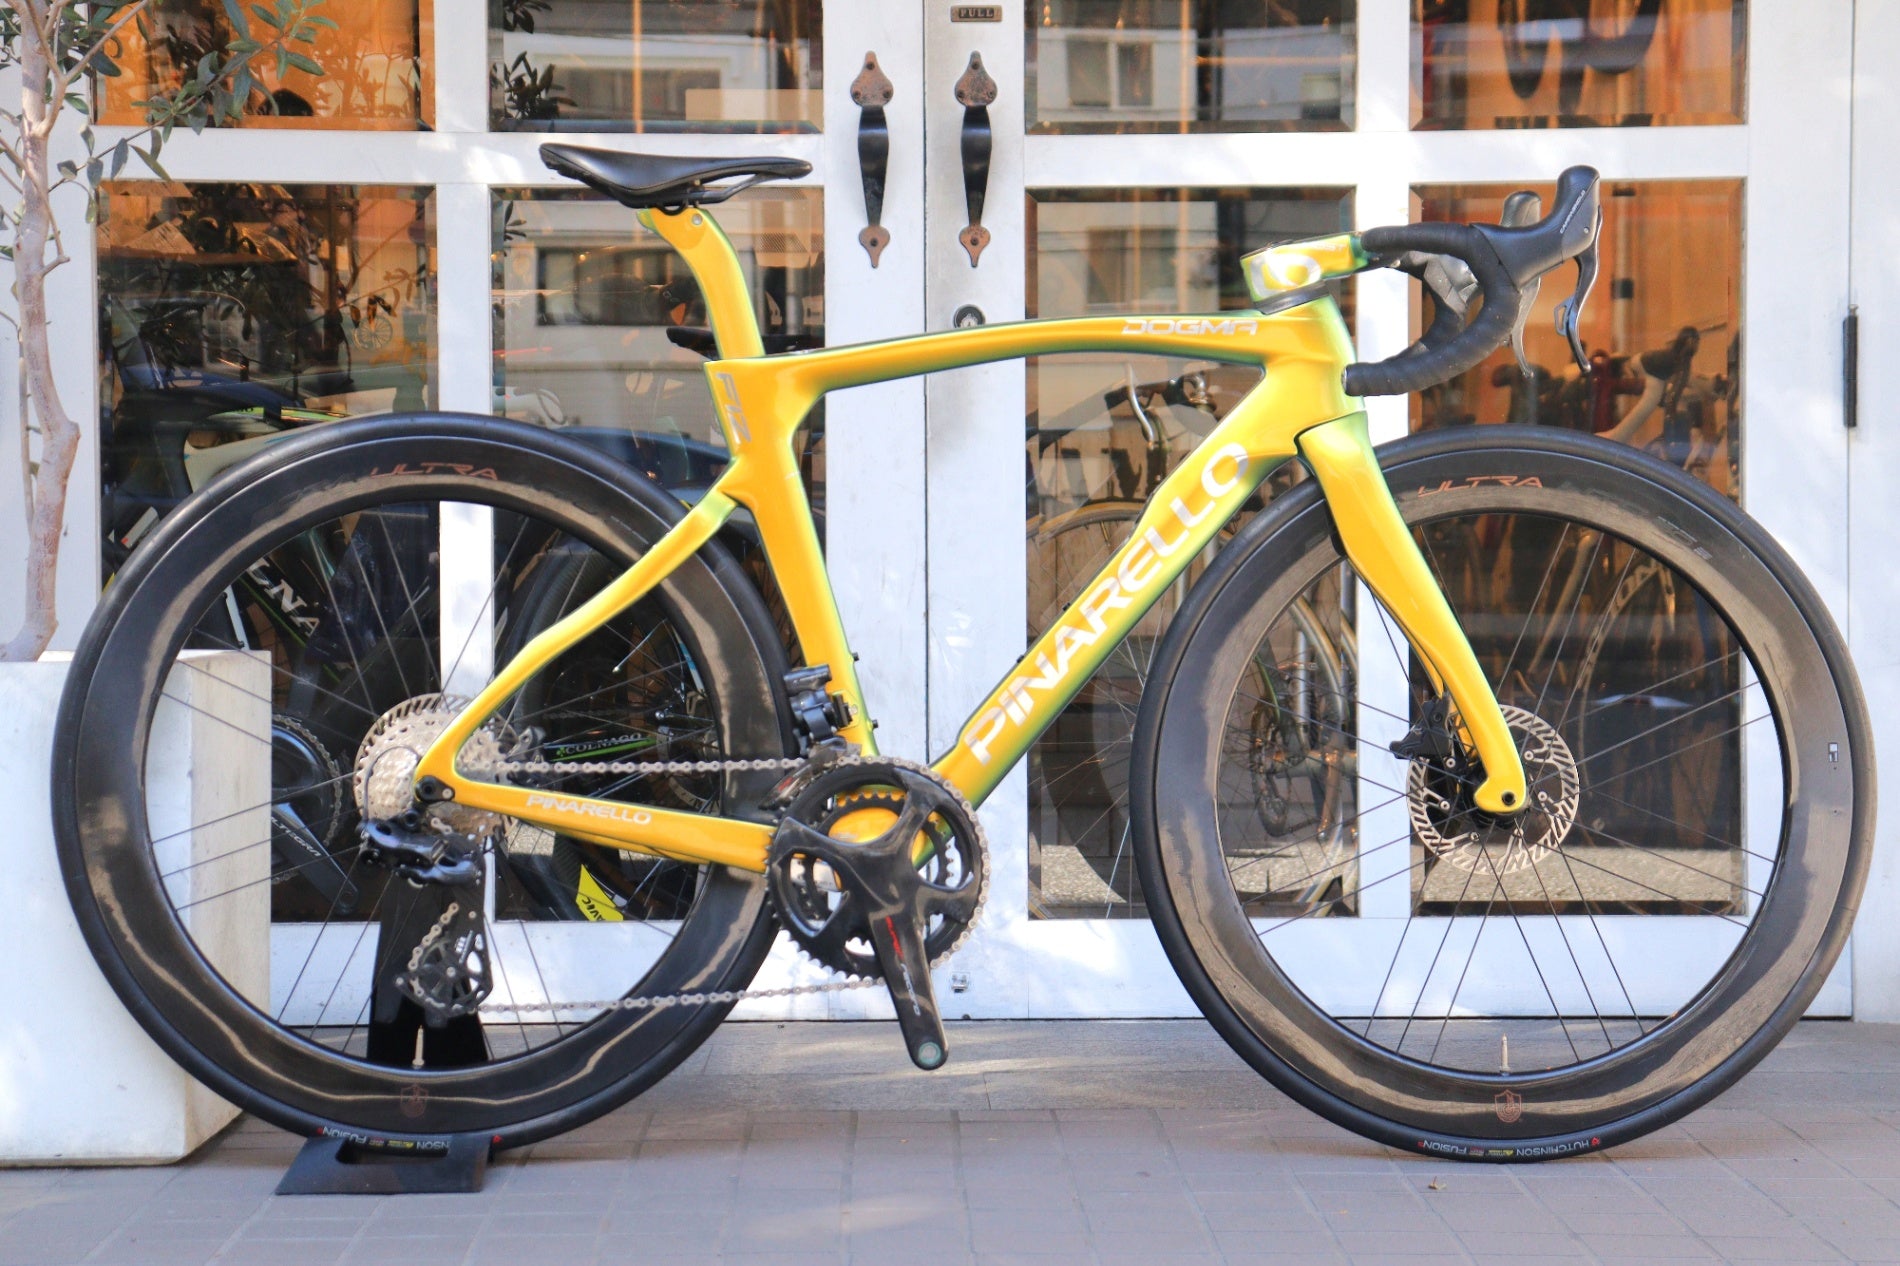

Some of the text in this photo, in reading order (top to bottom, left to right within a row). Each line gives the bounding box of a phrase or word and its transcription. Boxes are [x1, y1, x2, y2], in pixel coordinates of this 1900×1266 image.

[960, 7, 994, 18] PULL
[1121, 319, 1259, 336] DOGMA
[370, 462, 499, 481] ULTRA
[1418, 475, 1543, 498] ULTRA
[963, 442, 1250, 766] PINARELLO
[566, 732, 642, 755] COLNAGO
[526, 794, 652, 825] PINARELLO
[271, 816, 321, 857] LTEGRA
[1423, 1139, 1467, 1155] FUSION
[1516, 1139, 1590, 1157] HUTCHINSON
